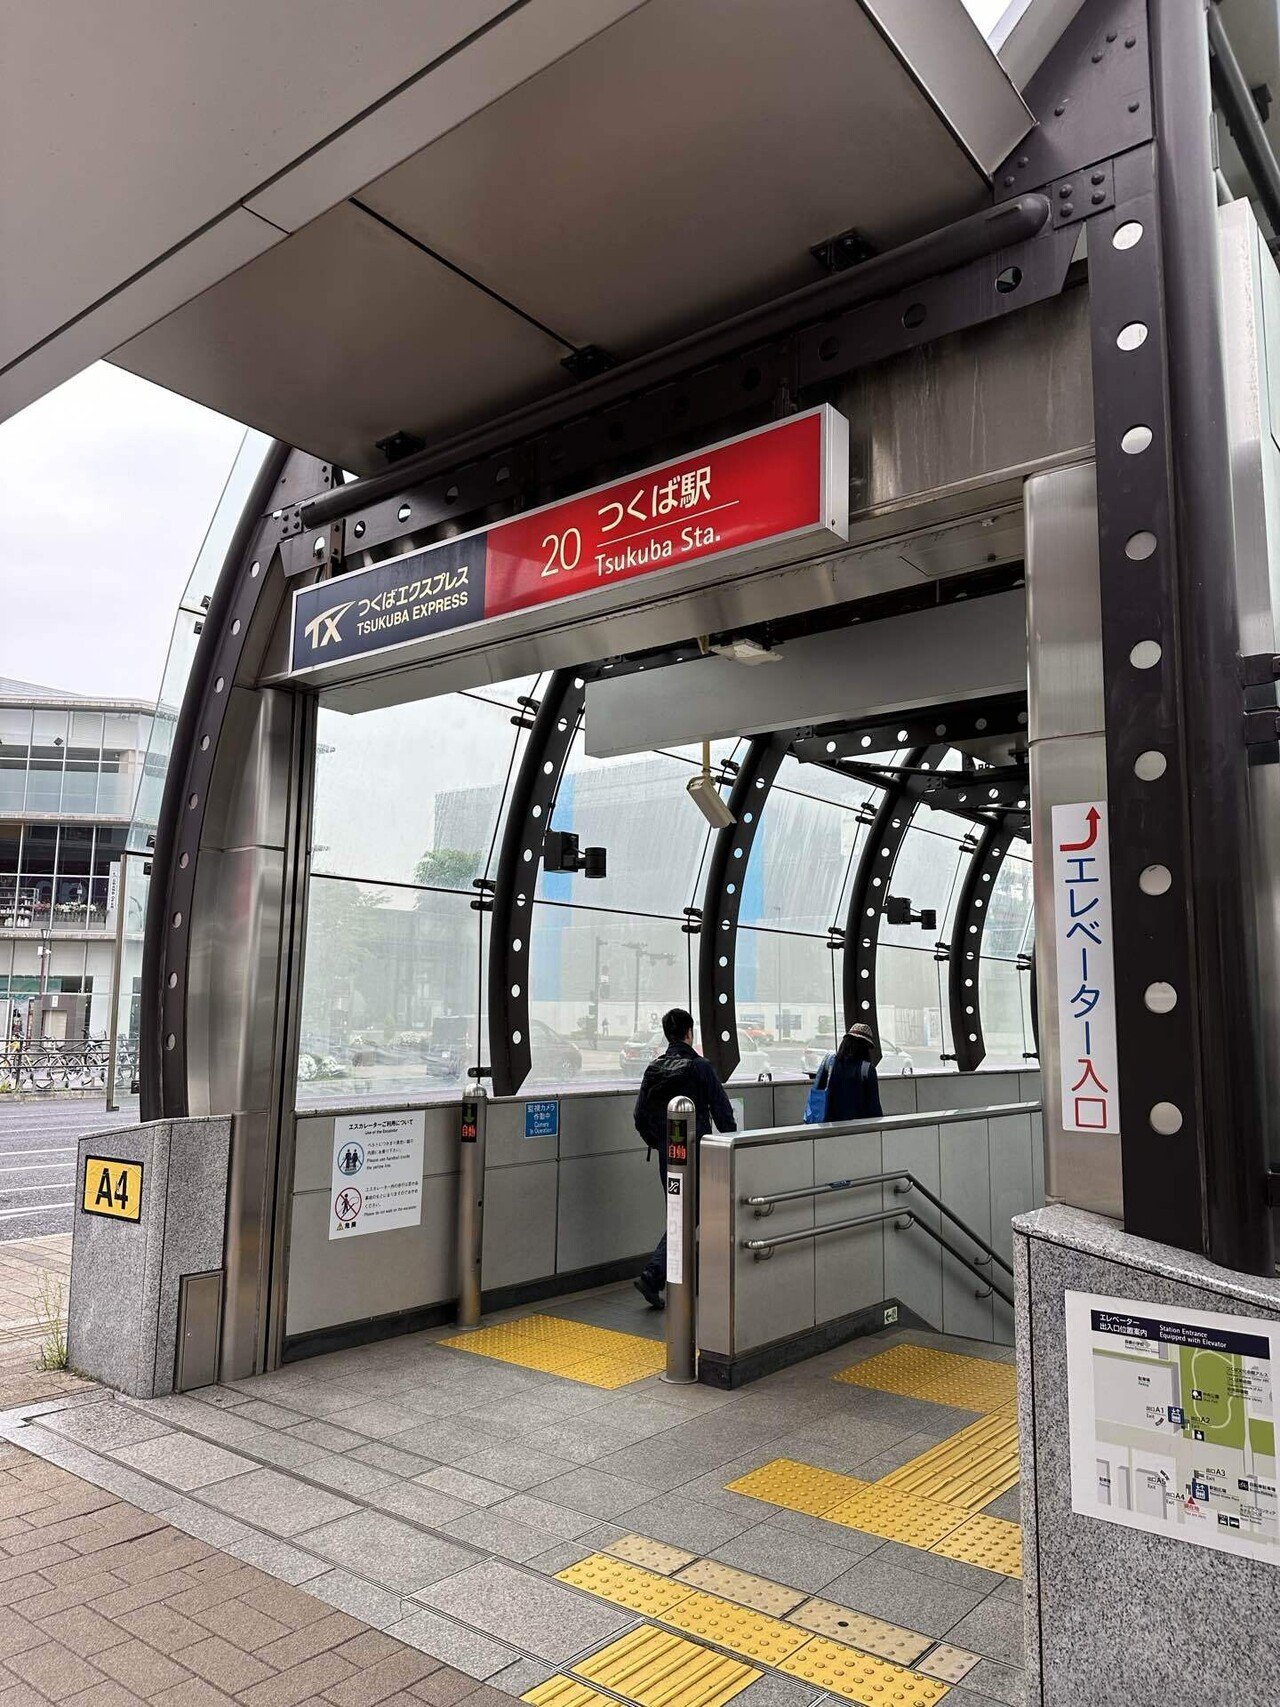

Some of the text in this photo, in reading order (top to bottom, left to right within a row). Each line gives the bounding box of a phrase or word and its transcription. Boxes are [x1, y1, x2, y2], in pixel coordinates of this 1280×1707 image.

[598, 465, 711, 532] つくば駅
[541, 527, 581, 577] 20
[594, 526, 720, 576] Tsukuba Sta.
[356, 591, 468, 636] TSUKUBA EXPRESS
[357, 566, 469, 617] つくばエクスプレス
[304, 600, 356, 649] TX
[1064, 857, 1108, 1130] エレベーター入口
[668, 1144, 686, 1159] 自動
[95, 1168, 128, 1210] A4
[1099, 1313, 1140, 1325] エレベーター
[1159, 1324, 1208, 1338] Station Entrance
[1159, 1331, 1228, 1349] Equipped with Elevator
